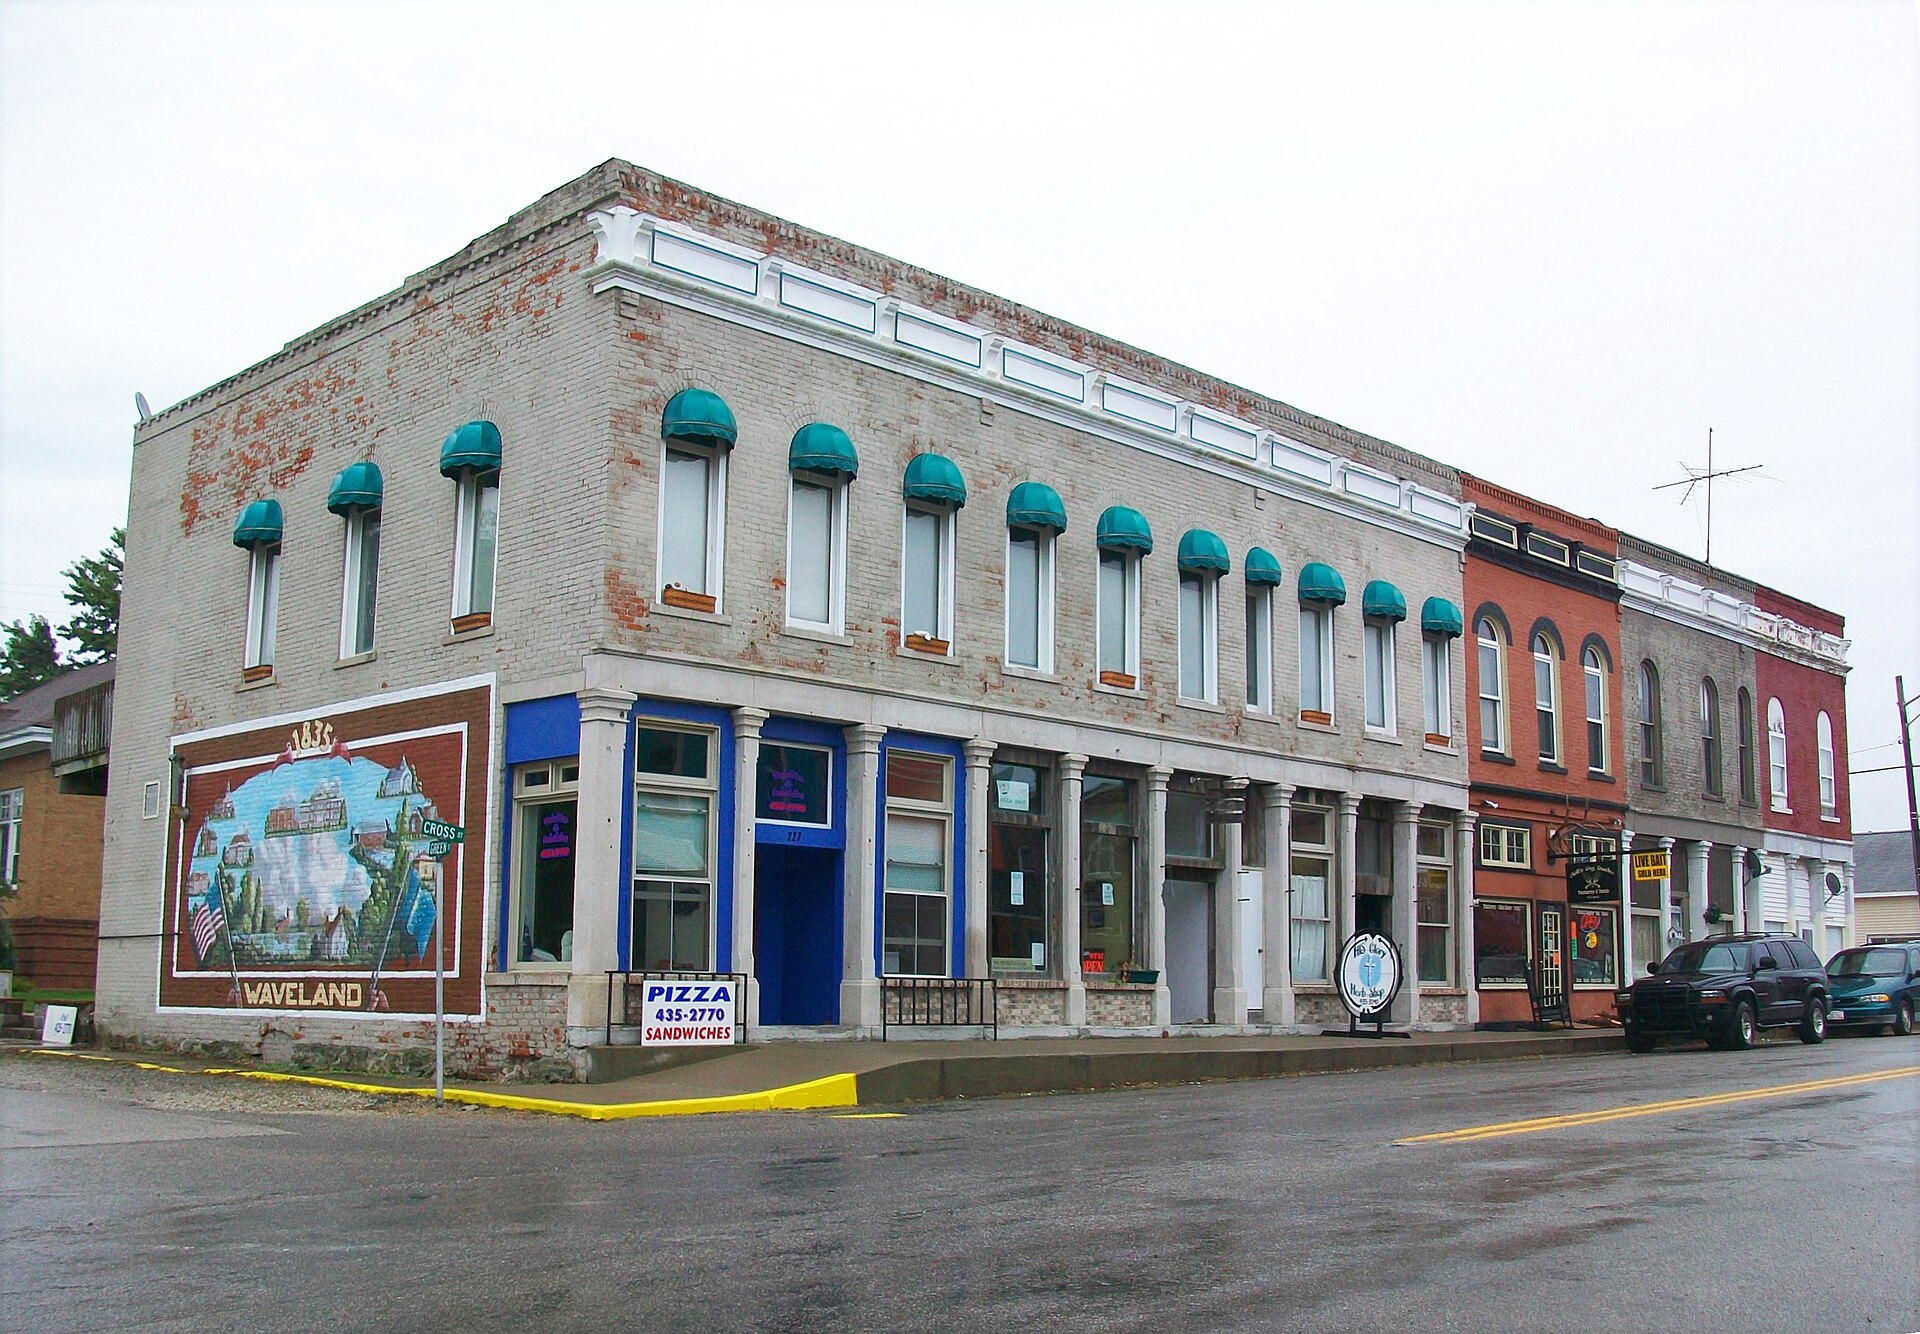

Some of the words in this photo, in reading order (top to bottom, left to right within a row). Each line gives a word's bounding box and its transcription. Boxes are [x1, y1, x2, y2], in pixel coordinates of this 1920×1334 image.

[292, 719, 335, 754] 1835
[423, 821, 456, 839] CROSS
[430, 842, 447, 855] GREEN
[1634, 855, 1650, 868] LIVE
[1651, 854, 1667, 867] BAIT
[1637, 869, 1651, 878] SOLD
[1652, 868, 1667, 877] HERE
[1370, 943, 1387, 959] Glory
[244, 982, 362, 1007] WAVELAND
[647, 986, 731, 1002] PIZZA
[1350, 983, 1366, 997] Herb
[1369, 986, 1385, 1000] Shop
[655, 1008, 726, 1022] 435-2770
[645, 1026, 731, 1041] SANDWICHES
